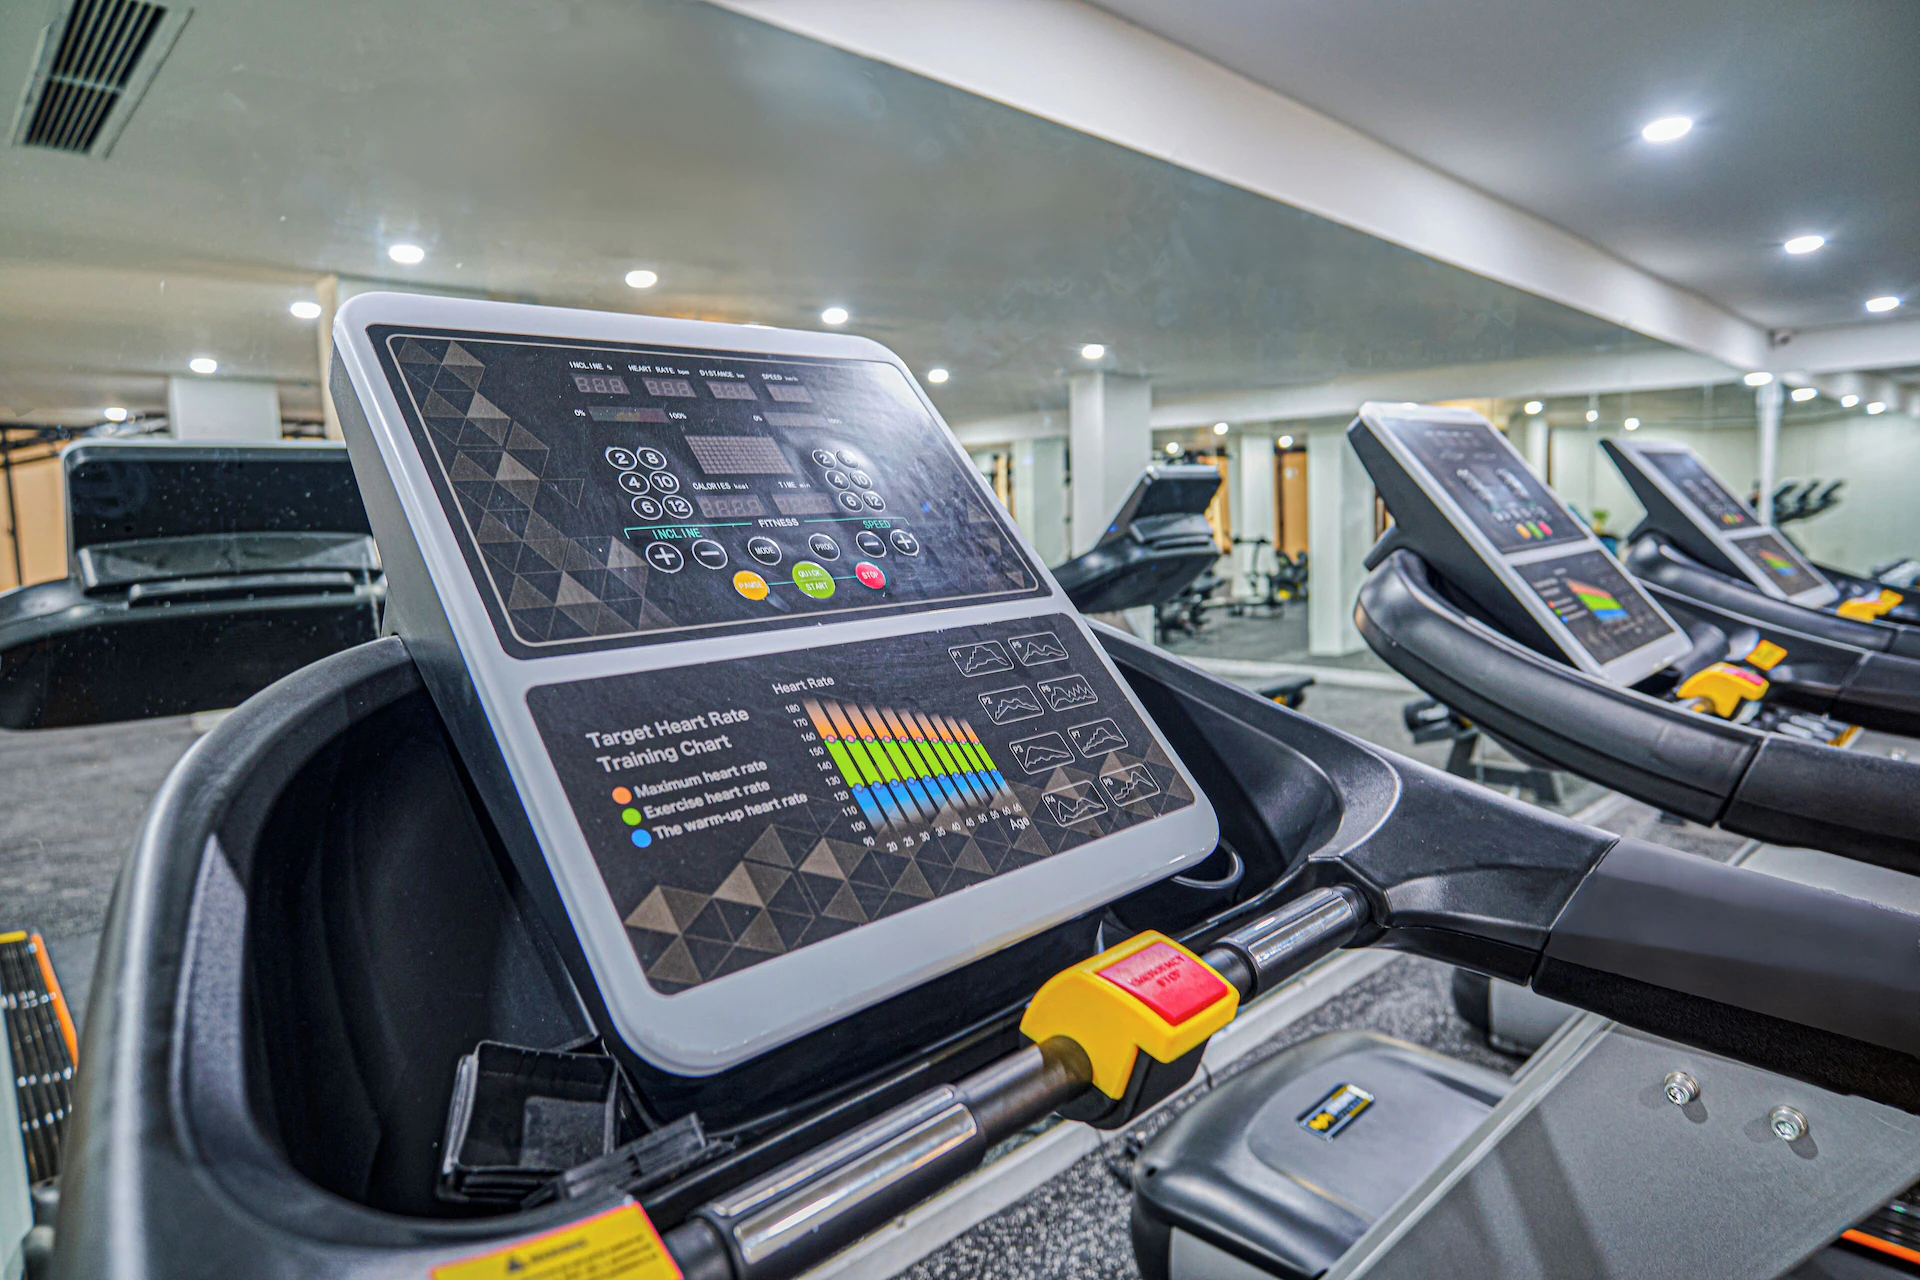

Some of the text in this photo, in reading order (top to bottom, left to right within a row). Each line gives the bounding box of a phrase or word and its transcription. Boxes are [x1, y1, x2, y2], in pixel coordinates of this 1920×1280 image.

[568, 361, 604, 370] INCLINE
[628, 365, 652, 373] HEART
[655, 366, 675, 375] RATE
[699, 369, 734, 378] DISTANCE
[761, 373, 783, 381] SPEED
[574, 409, 586, 417] 0%
[668, 411, 687, 420] 100%
[615, 452, 629, 465] 2
[646, 452, 659, 464] 8
[819, 454, 831, 464] 2
[843, 455, 853, 464] 8
[628, 476, 641, 488] 4
[654, 476, 674, 488] 10
[778, 481, 797, 489] TIME
[834, 475, 844, 485] 4
[852, 475, 868, 485] 10
[692, 482, 732, 490] CALORIES
[846, 497, 856, 506] 6
[866, 496, 882, 506] 12
[641, 501, 654, 514] 6
[667, 500, 689, 513] 12
[756, 518, 800, 528] FITNESS
[863, 520, 891, 529] SPEED
[652, 528, 703, 540] INCLINE
[754, 546, 776, 555] MODE
[815, 543, 834, 551] PROG
[861, 571, 879, 580] STOP
[737, 581, 764, 590] PAUSE
[805, 582, 829, 591] START
[1012, 641, 1022, 649] P5
[952, 650, 962, 658] P1
[771, 676, 835, 695] Heart Rate
[982, 696, 993, 705] P2
[785, 703, 800, 714] 180
[793, 718, 809, 728] 170
[585, 708, 750, 750] Target Heart Rate
[1071, 730, 1081, 738] P7
[801, 732, 816, 742] 160
[596, 734, 733, 773] Training Chart
[809, 746, 825, 757] 150
[1013, 744, 1024, 753] P3
[817, 761, 833, 772] 140
[633, 759, 768, 799] Maximum heart rate
[825, 776, 841, 787] 130
[642, 780, 771, 820] Exercise heart rate
[833, 791, 850, 802] 120
[652, 792, 808, 840] The warm-up heart rate
[842, 806, 858, 817] 110
[851, 821, 867, 833] 100
[886, 803, 1022, 853] 20 25 30 35 40 45 50 55 60 65
[1009, 817, 1030, 831] Age
[863, 835, 876, 847] 90
